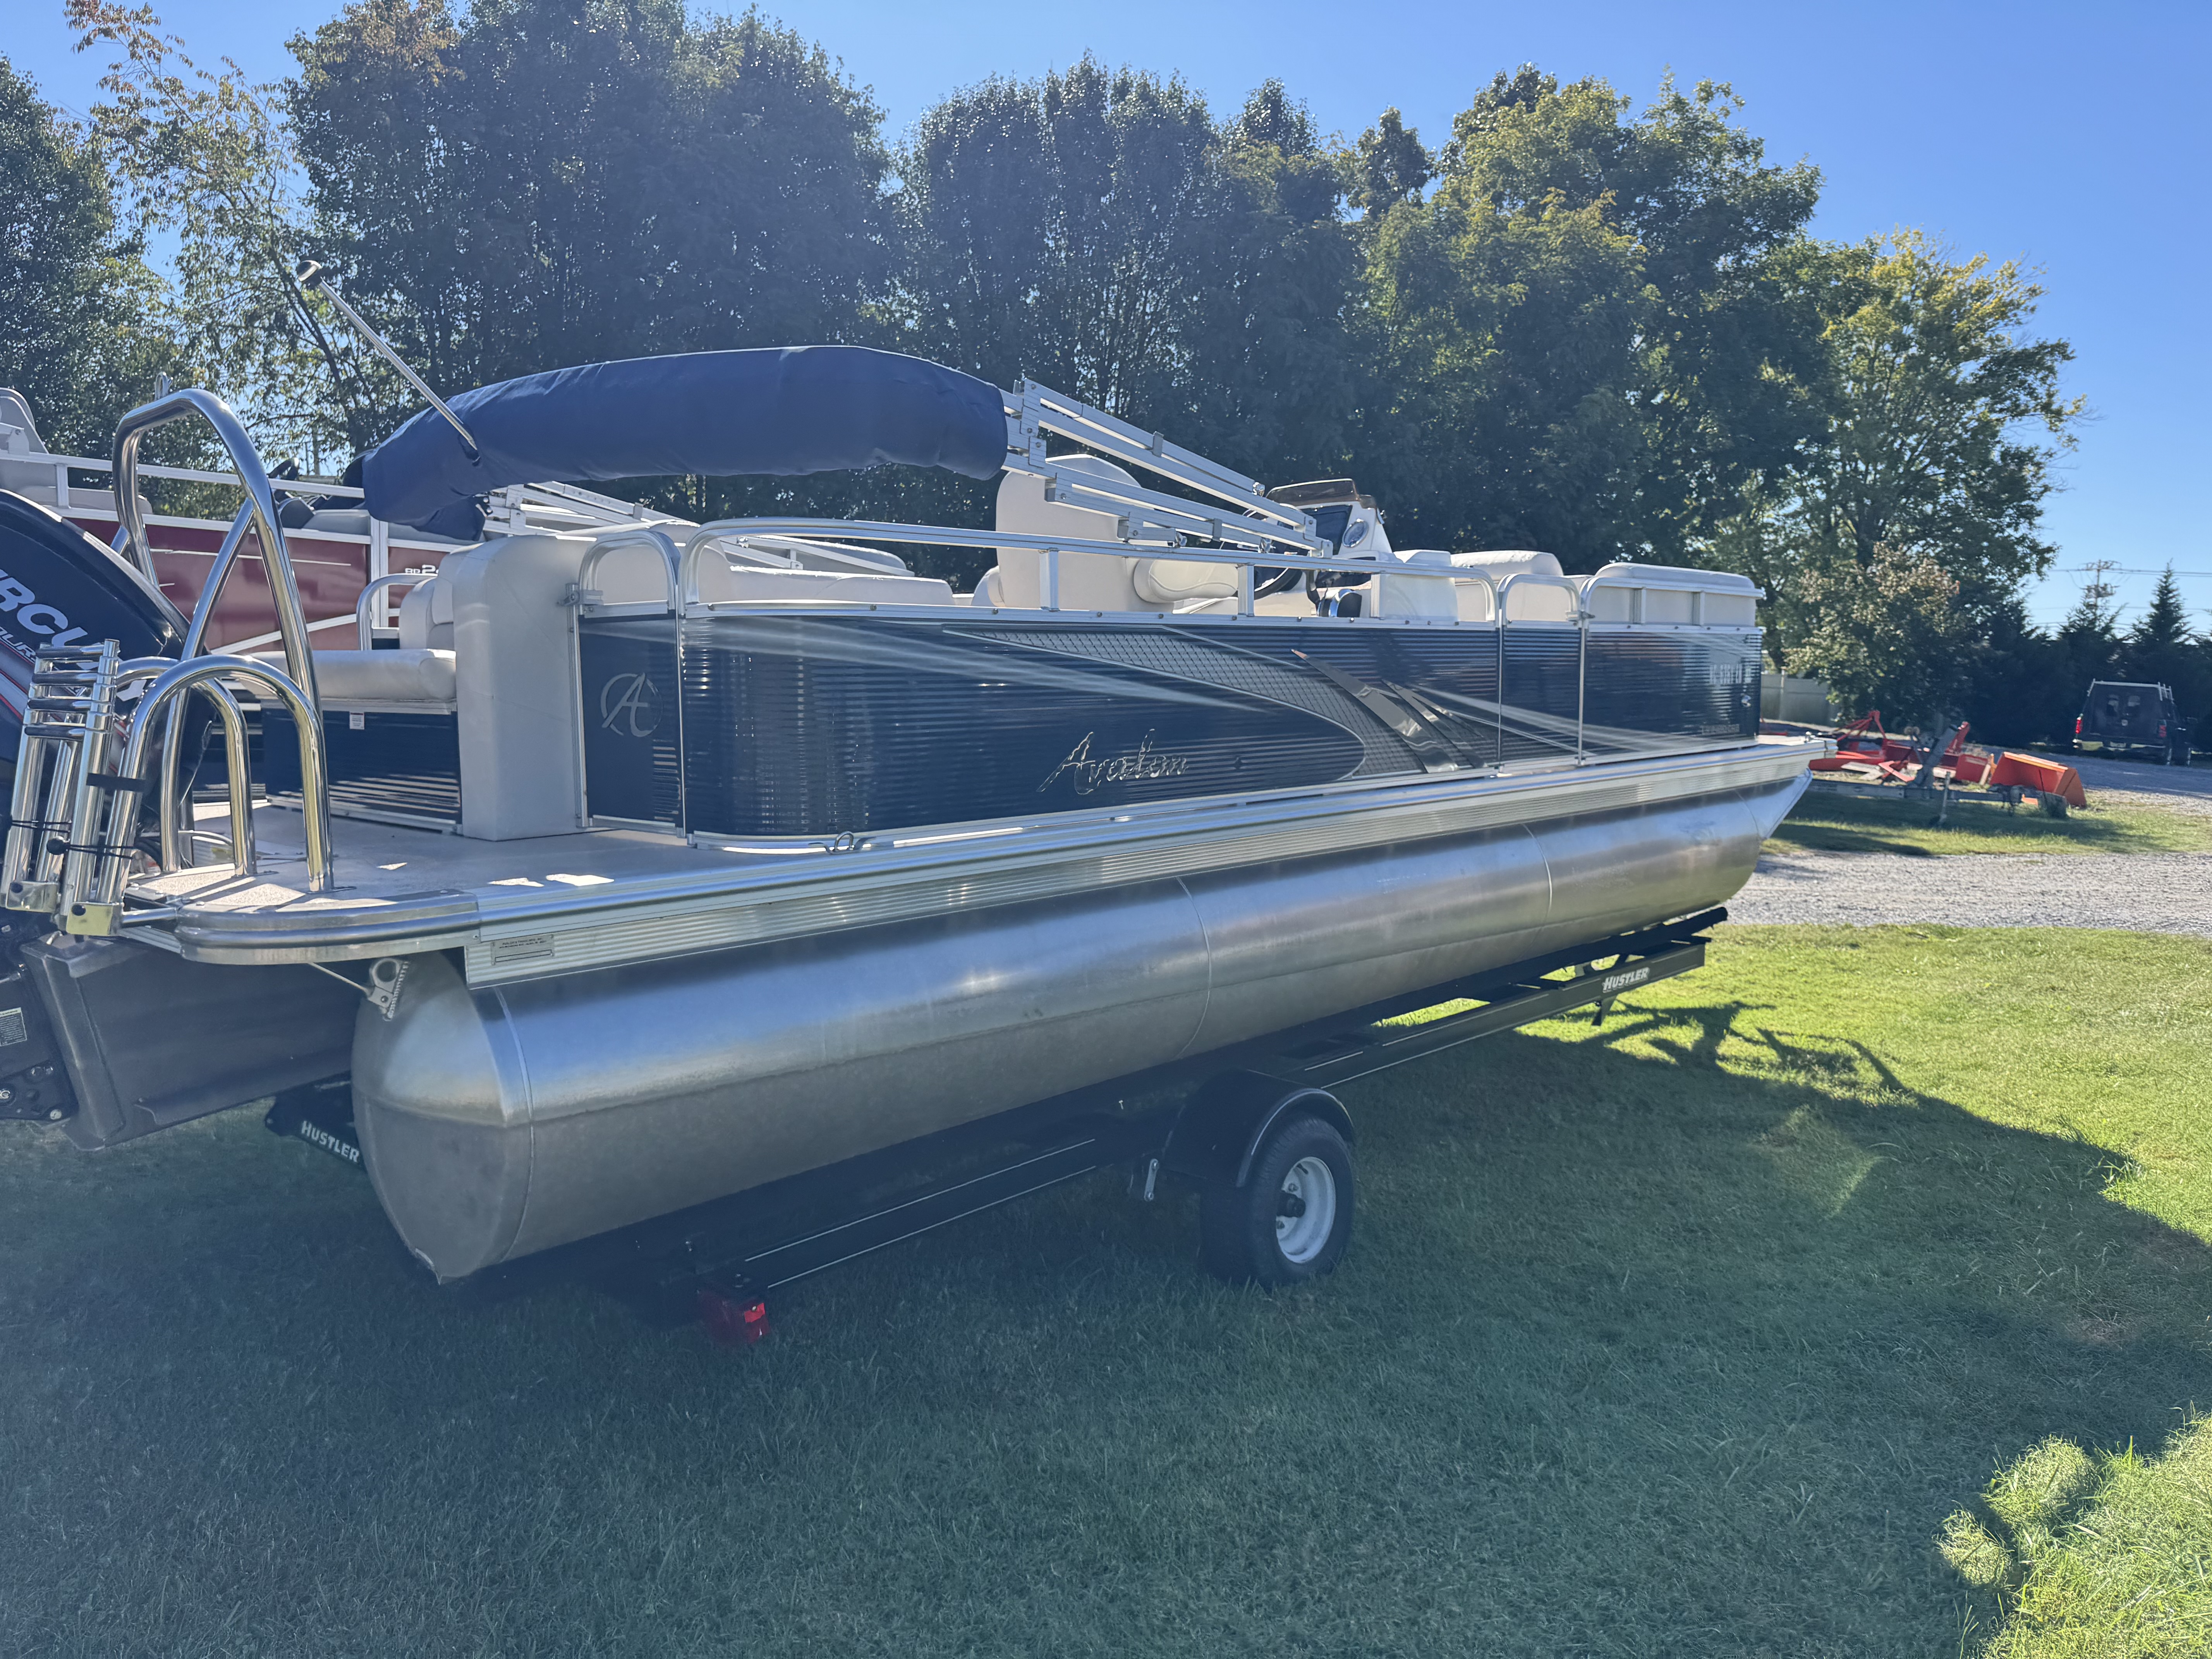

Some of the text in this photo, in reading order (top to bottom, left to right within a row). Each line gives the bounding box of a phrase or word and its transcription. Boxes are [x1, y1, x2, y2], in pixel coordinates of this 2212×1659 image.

[1036, 728, 1188, 795] Avalon
[1602, 967, 1650, 993] HUSTLER
[301, 1121, 359, 1162] HUSTLER
